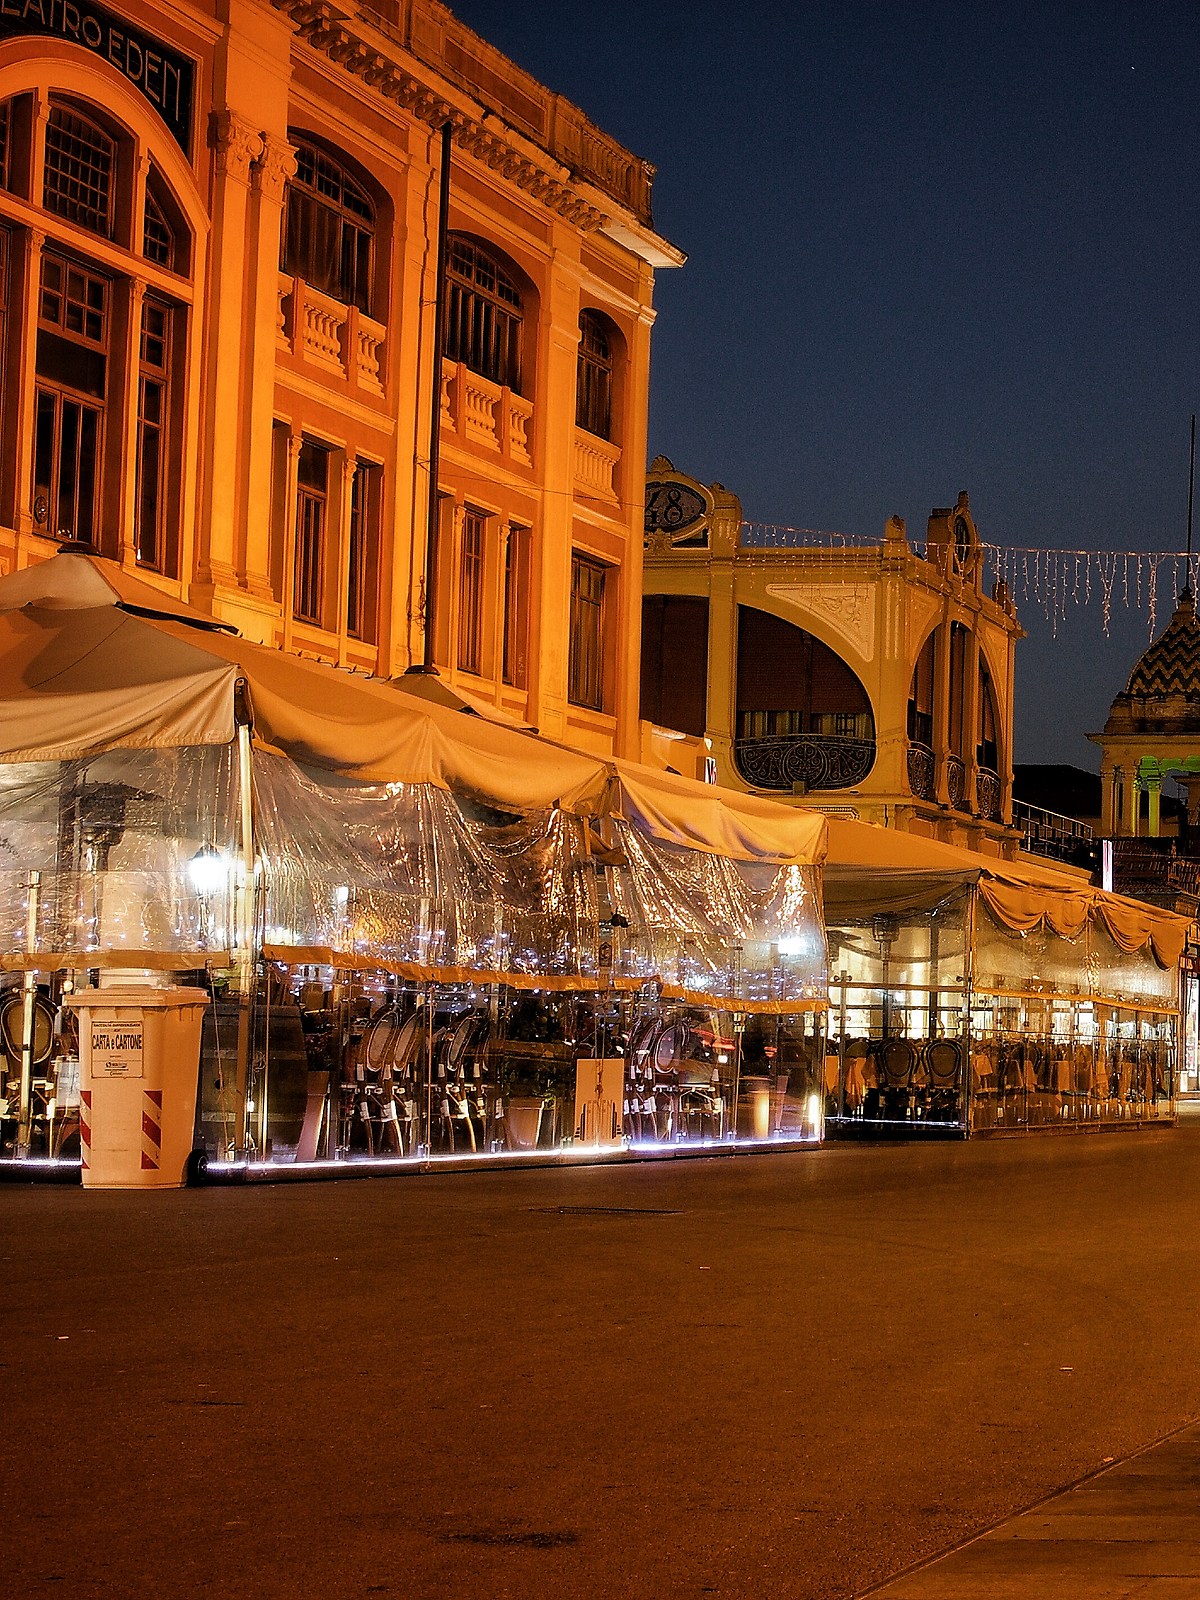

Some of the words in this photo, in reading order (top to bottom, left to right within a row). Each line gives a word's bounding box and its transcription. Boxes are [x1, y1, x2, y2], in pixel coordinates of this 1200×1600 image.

[108, 27, 181, 122] EDEN
[92, 1034, 111, 1050] CARTA
[115, 1034, 142, 1050] CARTONE
